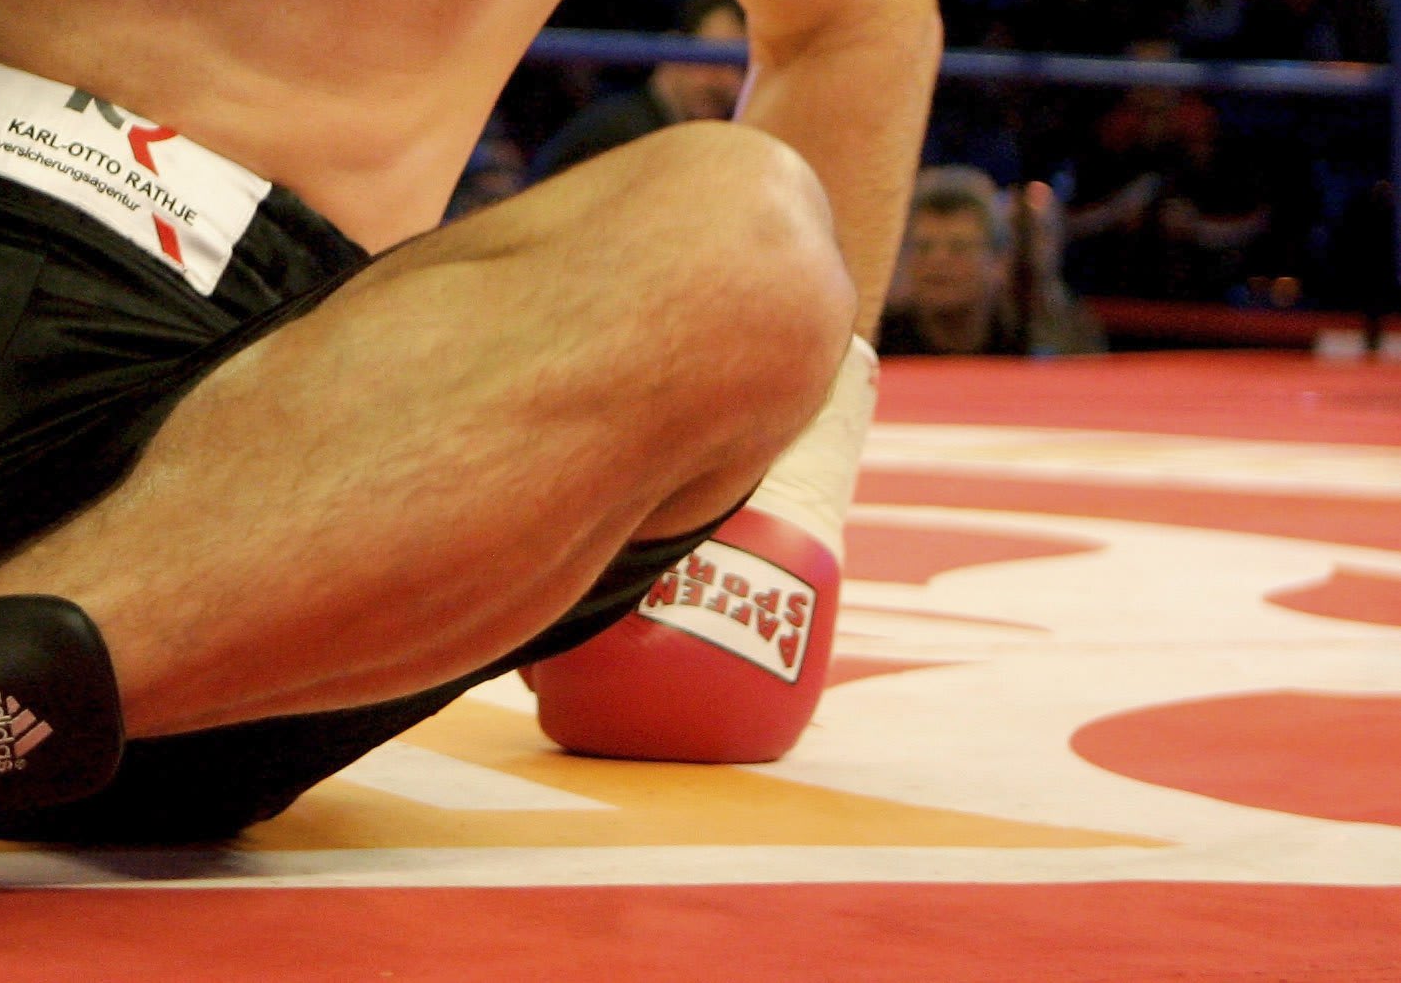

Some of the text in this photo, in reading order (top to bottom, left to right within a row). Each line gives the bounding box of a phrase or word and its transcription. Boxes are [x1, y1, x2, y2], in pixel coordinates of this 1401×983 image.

[8, 118, 122, 176] KARL-OTTO
[125, 171, 198, 228] RATHJE
[646, 575, 800, 669] PAFFEN
[675, 551, 809, 628] SPOR
